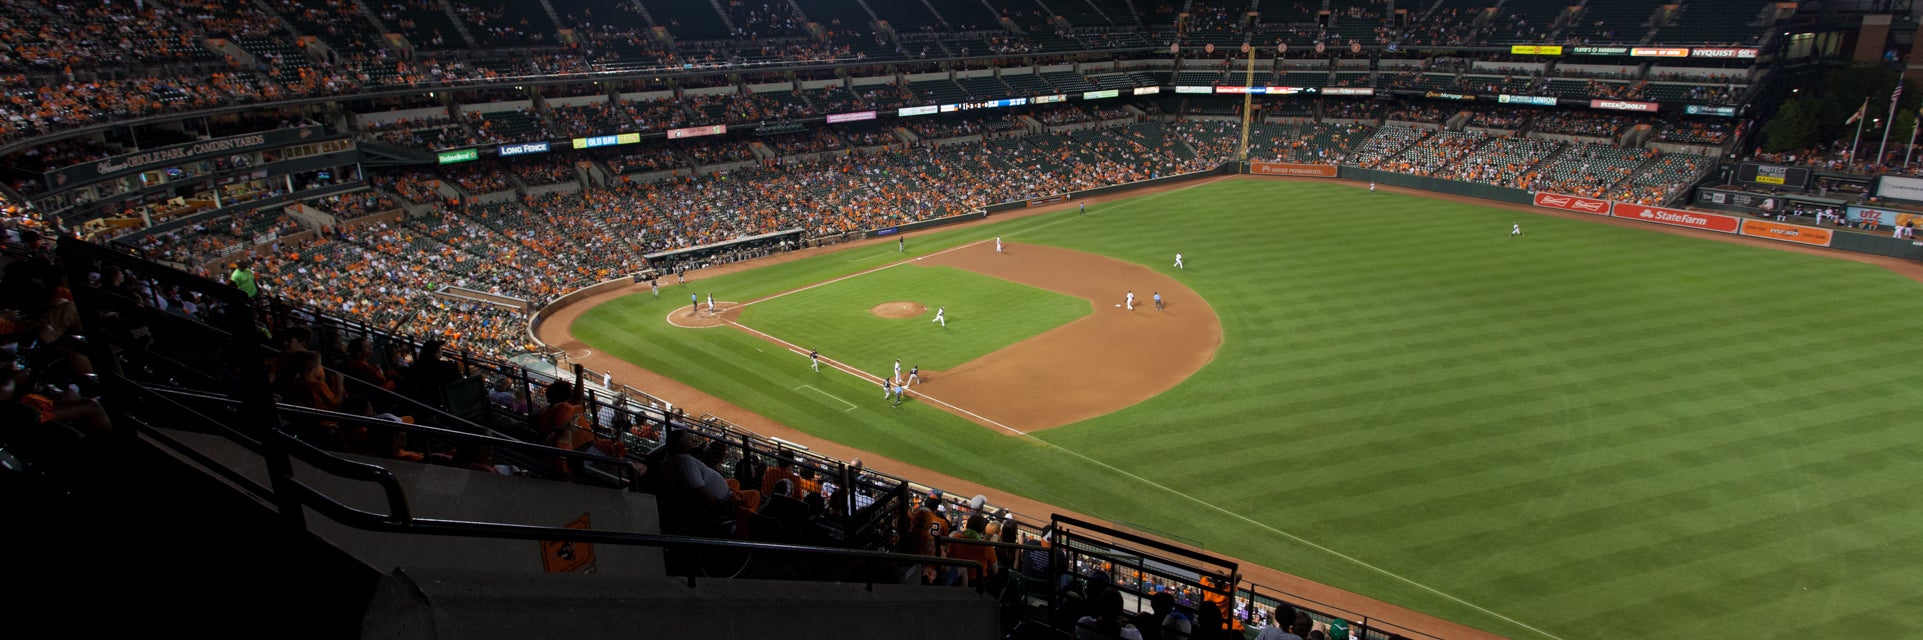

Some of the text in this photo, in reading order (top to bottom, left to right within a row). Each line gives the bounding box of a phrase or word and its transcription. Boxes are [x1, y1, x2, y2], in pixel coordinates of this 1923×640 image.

[160, 147, 186, 161] PARK
[193, 139, 234, 154] CAMDEN
[233, 135, 264, 148] YARDS
[501, 143, 547, 155] LONG FENCE
